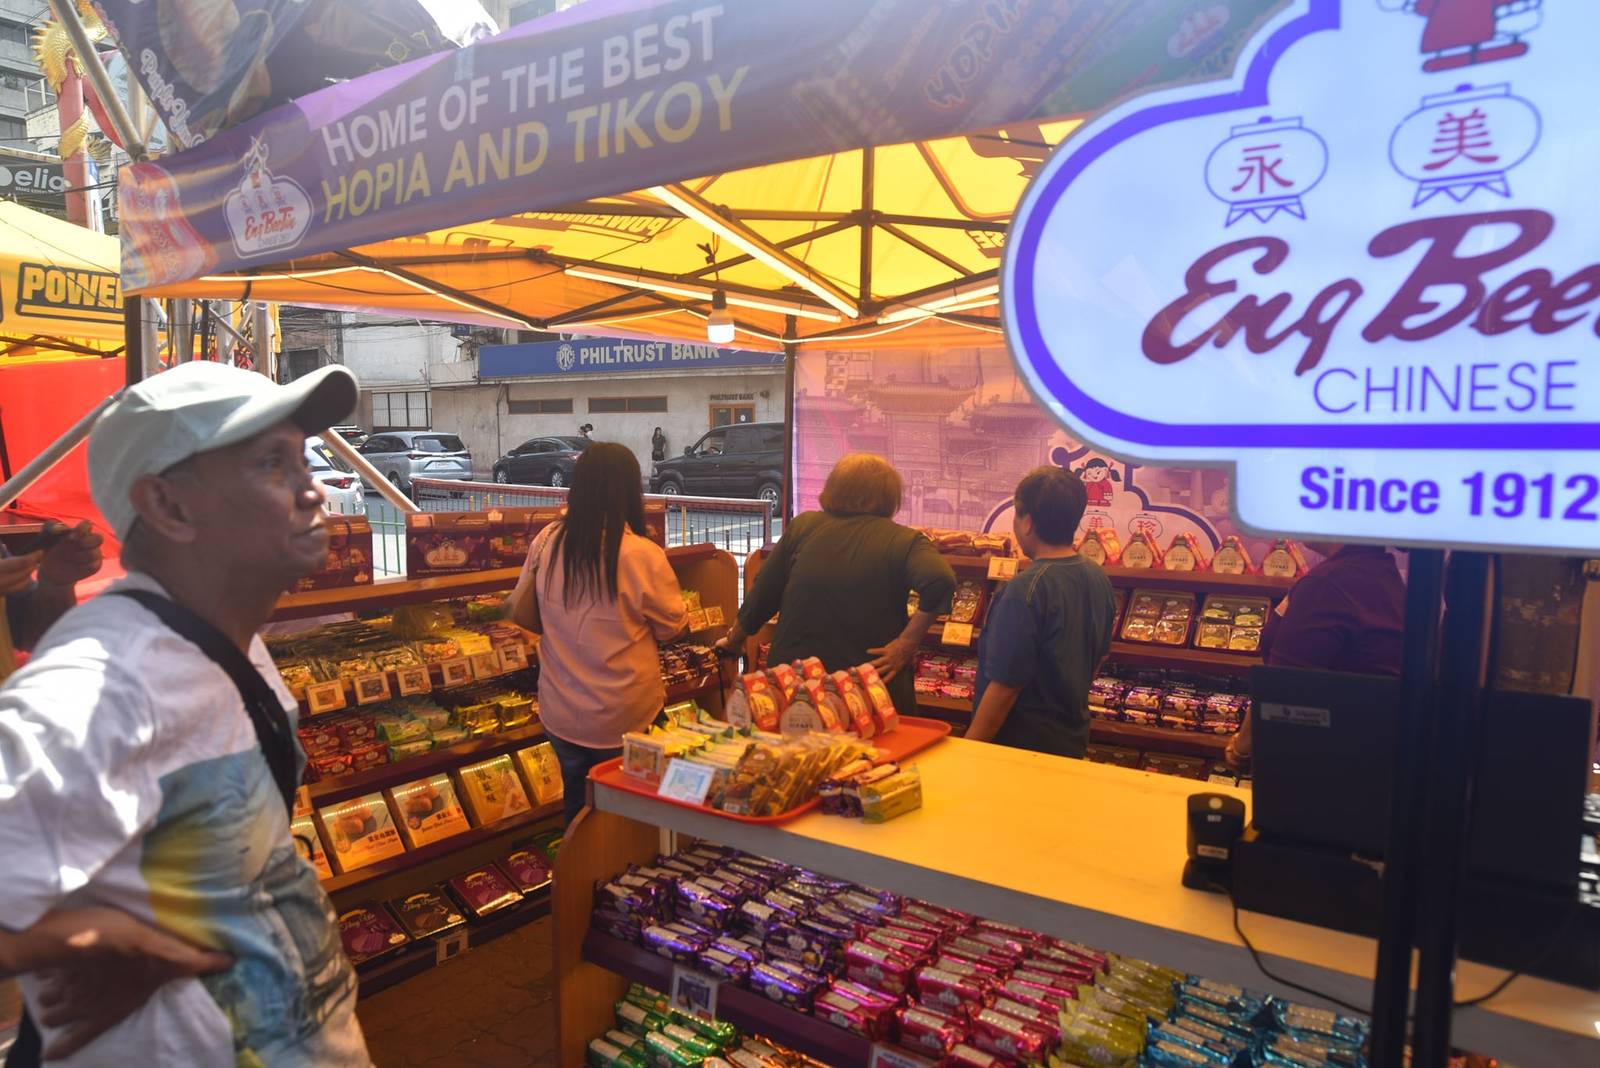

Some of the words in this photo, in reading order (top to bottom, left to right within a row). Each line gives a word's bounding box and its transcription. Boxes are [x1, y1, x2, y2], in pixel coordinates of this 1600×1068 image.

[322, 98, 427, 166] HOME
[439, 77, 489, 132] OF
[502, 48, 585, 113] THE
[603, 6, 725, 82] BEST
[321, 158, 431, 223] HOPIA
[444, 122, 548, 188] AND
[566, 65, 749, 164] TIKOY
[1231, 143, 1294, 194] 永
[1422, 107, 1499, 171] 美
[1141, 236, 1363, 376] Eng
[580, 343, 666, 365] PHILTRUST
[671, 342, 720, 361] BANK
[1313, 360, 1579, 413] CHINESE
[1299, 465, 1440, 515] Since
[1461, 470, 1600, 521] 1912
